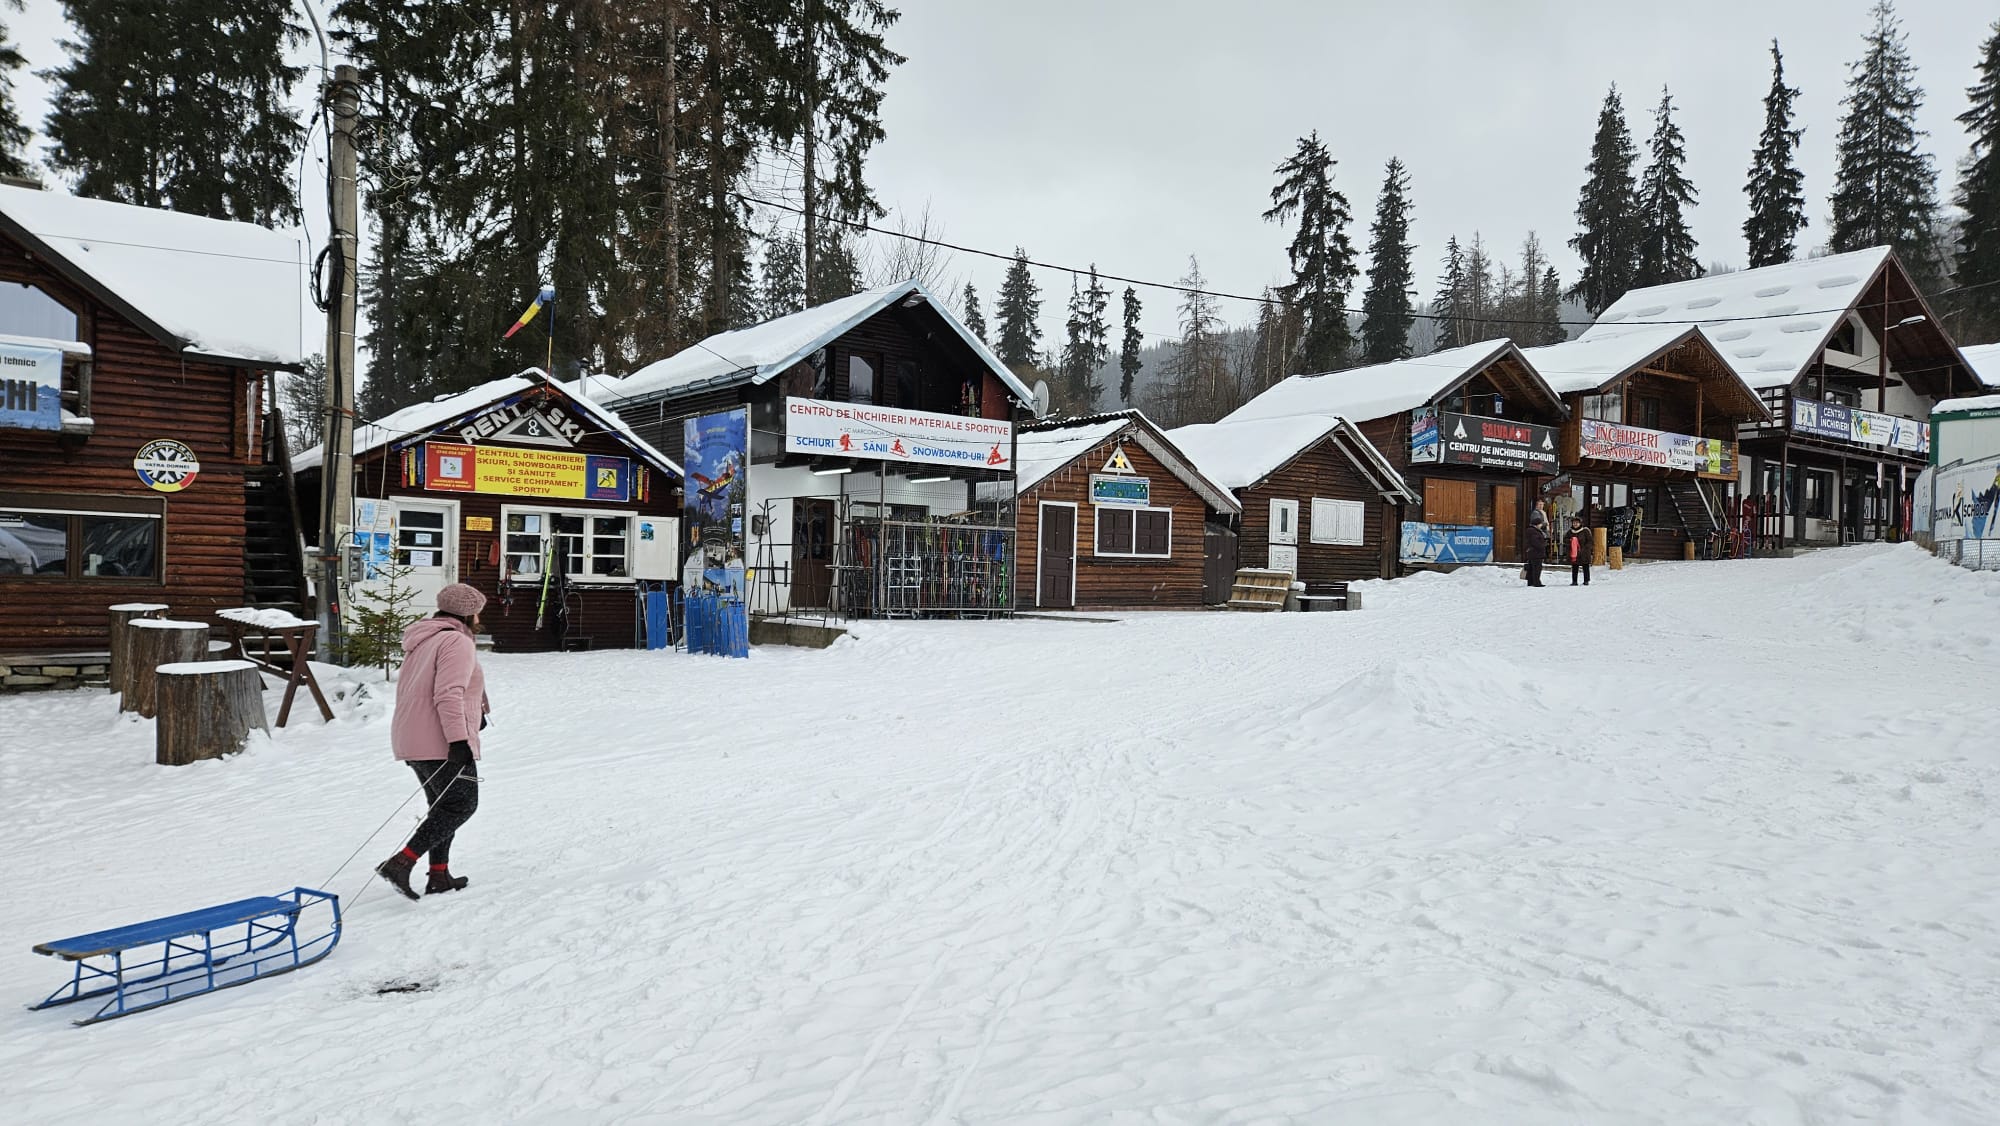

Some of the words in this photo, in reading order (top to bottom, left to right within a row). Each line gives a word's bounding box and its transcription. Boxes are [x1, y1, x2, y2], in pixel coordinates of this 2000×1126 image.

[4, 356, 36, 367] tehnice
[790, 404, 833, 417] CENTRU
[836, 409, 850, 419] DE
[909, 416, 963, 431] MATERIALE
[965, 423, 1009, 436] SPORTIVE
[1824, 408, 1846, 420] CENTRU
[460, 403, 523, 445] RENT
[528, 419, 540, 436] &
[546, 407, 586, 443] SKI
[1595, 425, 1658, 449] INCHIRIERI
[796, 437, 834, 448] SCHIURI
[912, 447, 985, 461] SNOWBOARD-URI
[1449, 442, 1480, 453] CENTRU
[1481, 446, 1492, 454] DE
[1529, 451, 1555, 463] SCHIURI
[477, 458, 511, 467] SKIURI,
[513, 460, 585, 472] SNOWBOARD-URI
[483, 476, 521, 484] SERVICE
[524, 478, 578, 488] ECHIPAMENT
[512, 486, 551, 494] SPORTIV
